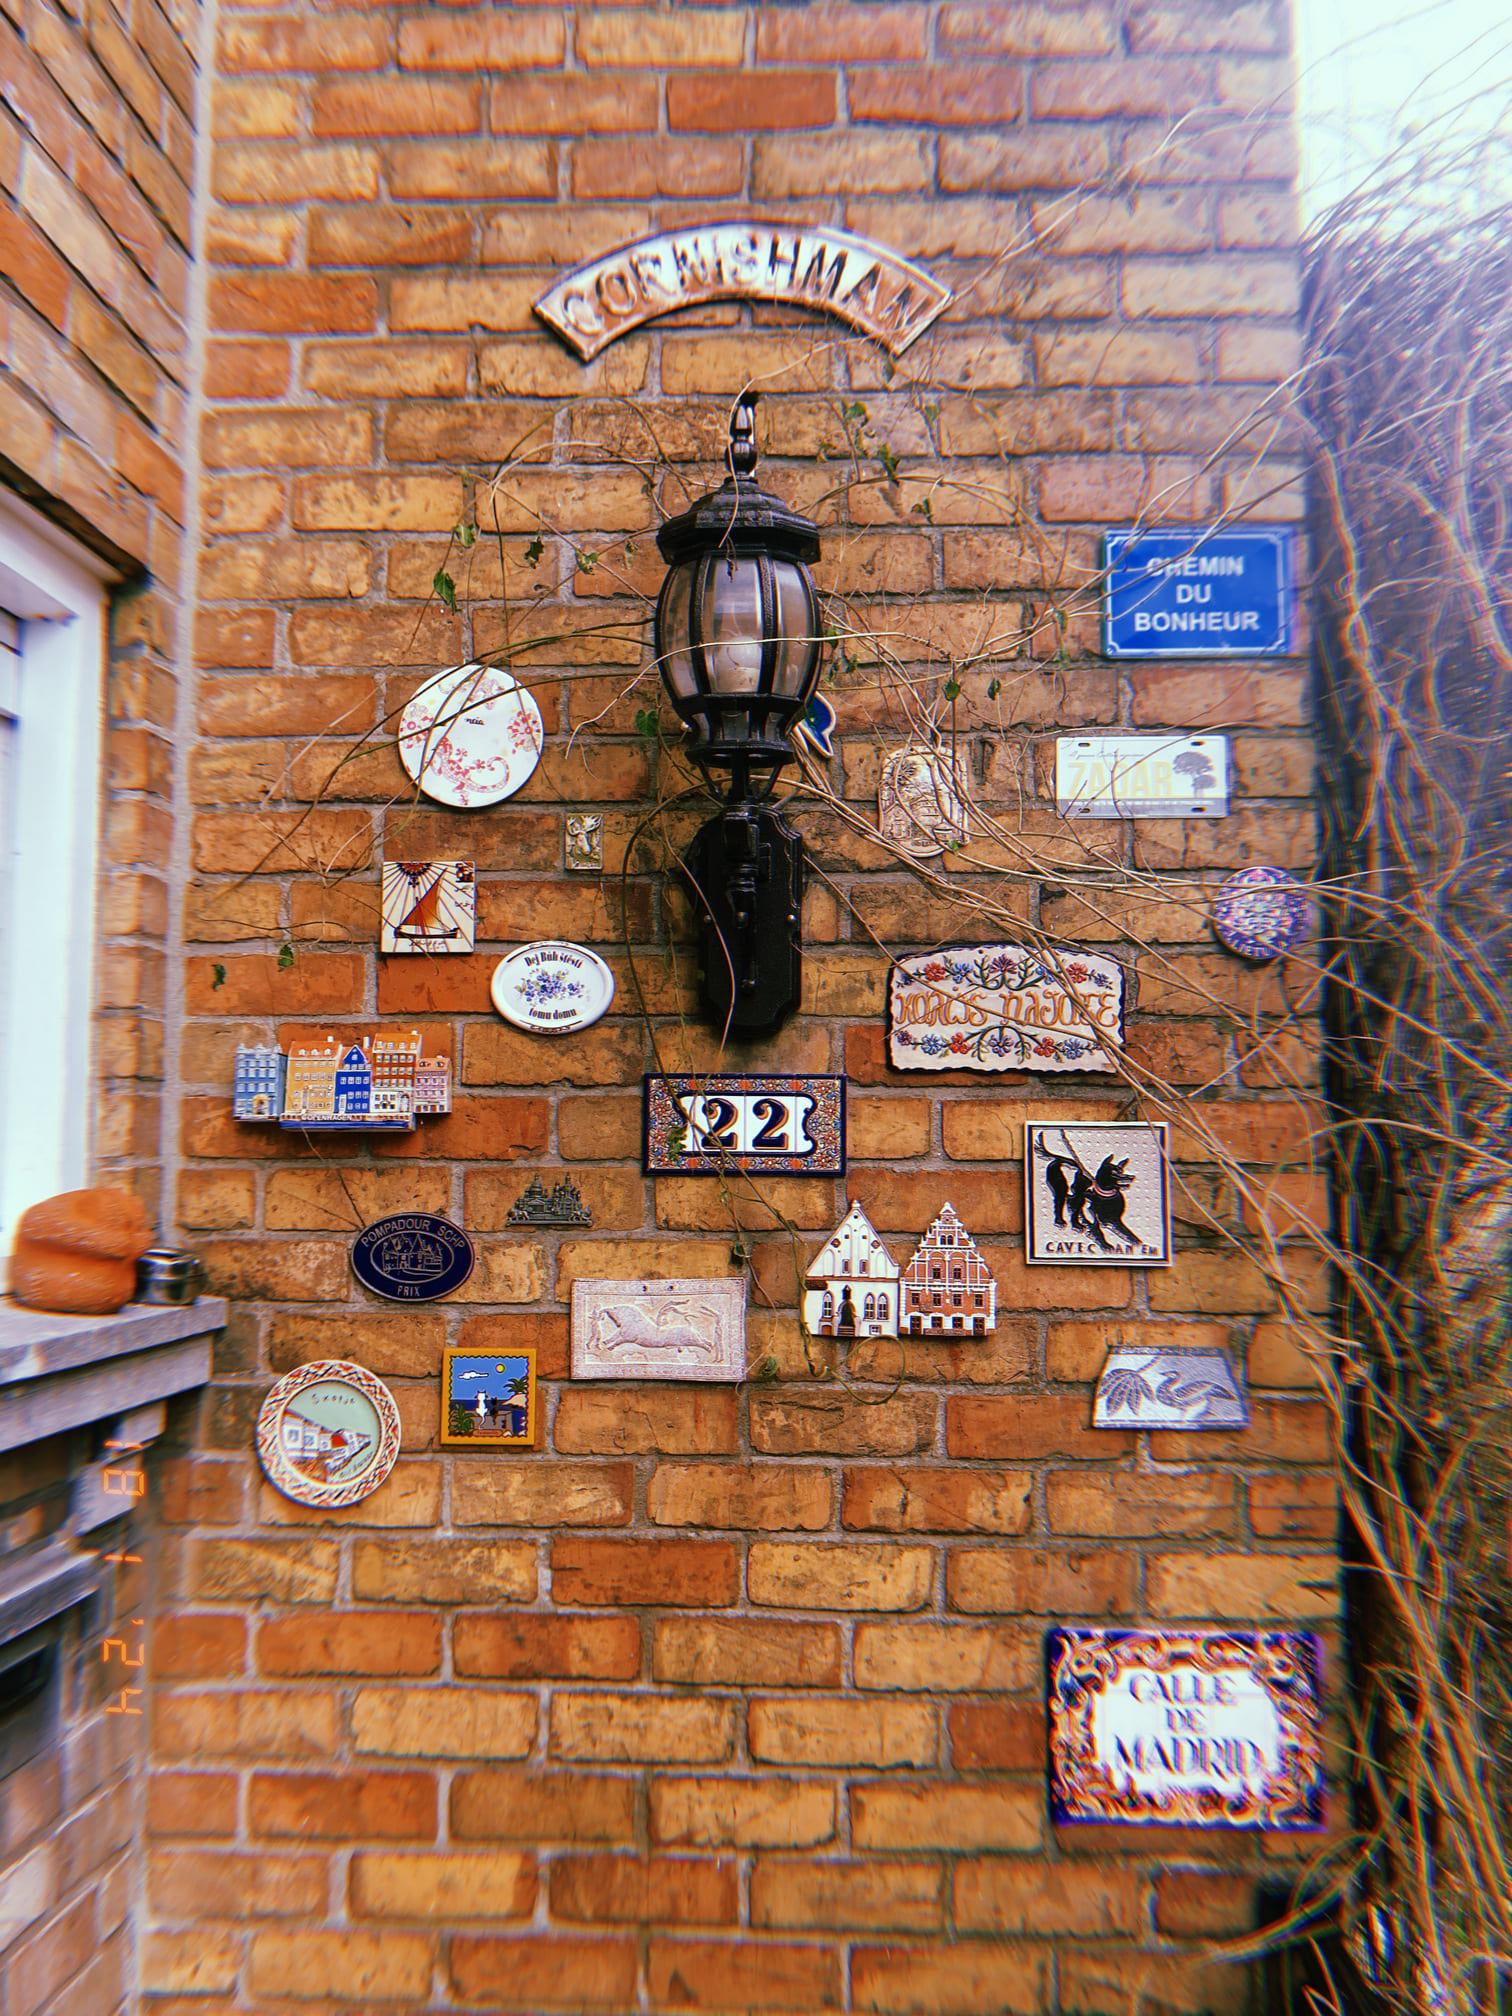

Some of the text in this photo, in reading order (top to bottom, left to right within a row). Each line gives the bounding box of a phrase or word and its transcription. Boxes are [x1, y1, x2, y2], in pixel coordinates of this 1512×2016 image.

[562, 231, 934, 334] CORNISHMAN
[1146, 555, 1245, 577] CHEMIN
[1176, 583, 1212, 604] DU
[1134, 611, 1261, 632] BONHEUR
[1068, 760, 1174, 798] ZADAR
[528, 1007, 578, 1020] tomu domu
[701, 1097, 790, 1150] 22
[360, 1218, 467, 1249] POMPADOUR SCHP
[1045, 1241, 1084, 1254] CAVE
[397, 1285, 421, 1297] PRIX
[1129, 1673, 1239, 1707] CALLE
[1165, 1708, 1209, 1735] DE
[1113, 1734, 1267, 1782] MADRID
